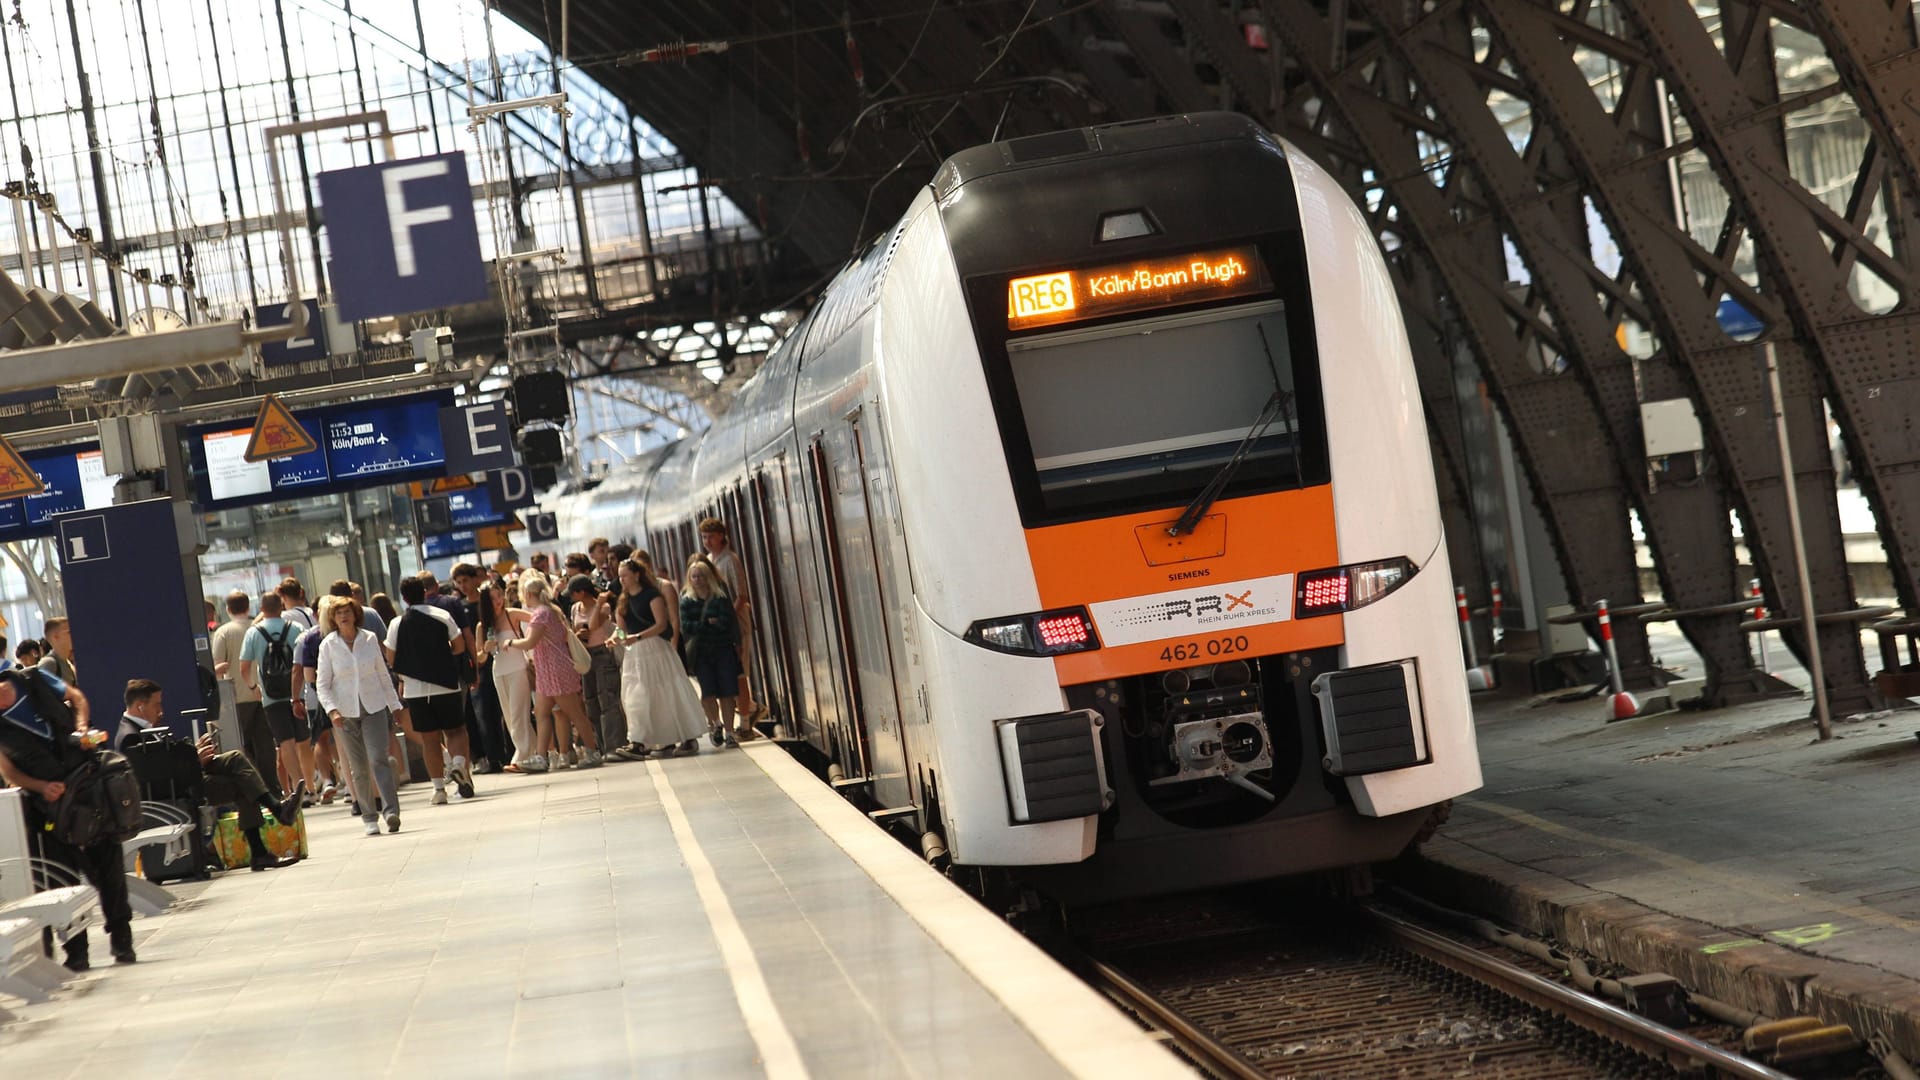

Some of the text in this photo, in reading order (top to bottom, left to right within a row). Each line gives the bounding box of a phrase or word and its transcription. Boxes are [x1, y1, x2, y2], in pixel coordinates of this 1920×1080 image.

[381, 160, 453, 278] F
[1088, 257, 1247, 297] Köln/Bonn Flugh.
[1016, 277, 1069, 314] RE6
[281, 302, 315, 350] 2
[331, 426, 353, 438] 11:52
[331, 436, 375, 450] Köln/Bonn
[464, 403, 502, 456] E
[500, 468, 527, 502] D
[535, 513, 554, 537] C
[1167, 568, 1211, 582] SIEMENS
[1160, 589, 1254, 621] RRX
[1197, 607, 1276, 625] RHEIN RUHR XPRESS
[1159, 635, 1249, 663] 462 020
